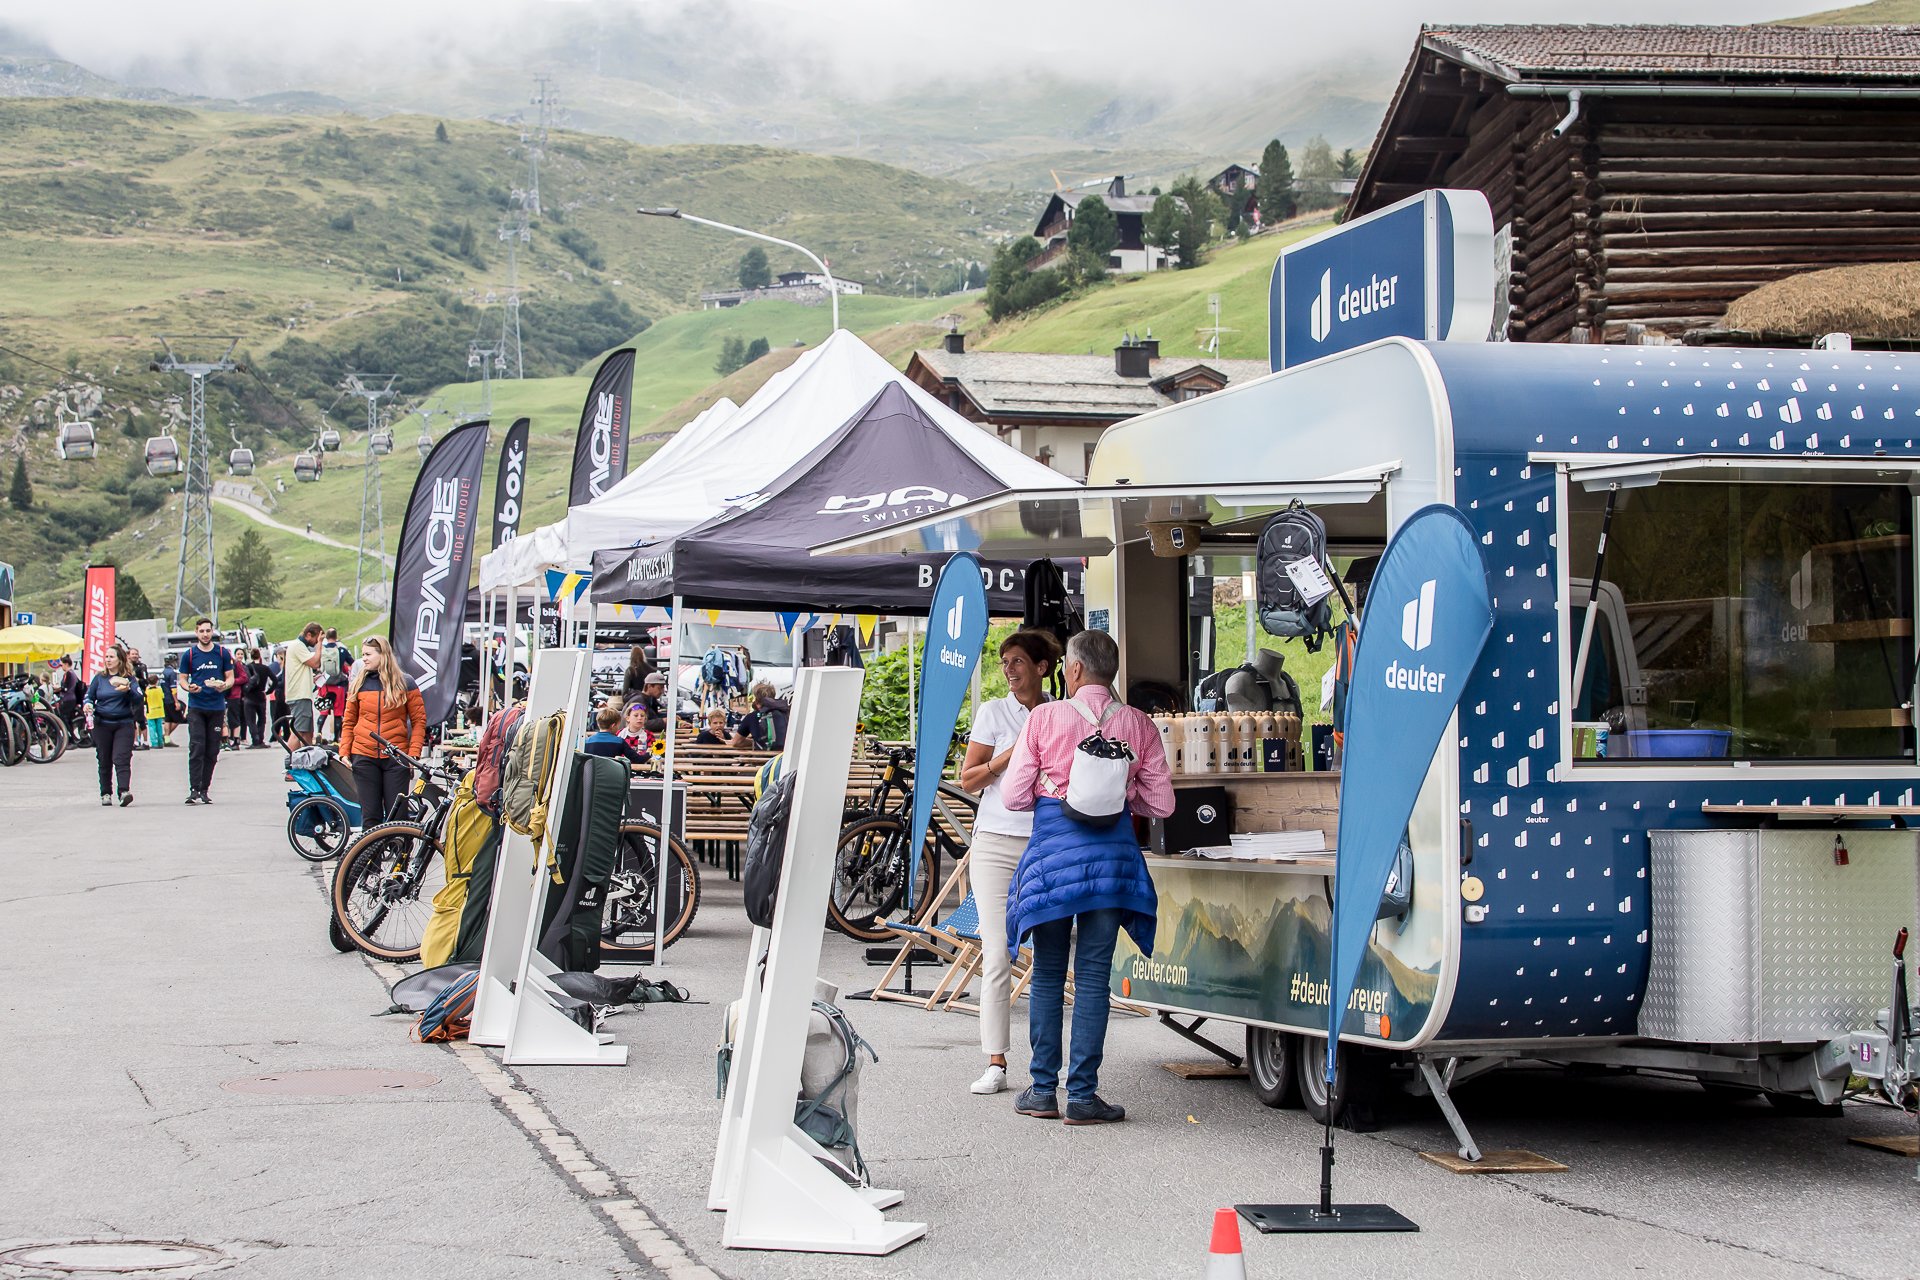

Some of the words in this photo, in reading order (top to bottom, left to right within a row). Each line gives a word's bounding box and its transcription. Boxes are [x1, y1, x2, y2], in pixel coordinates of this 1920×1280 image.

[1338, 273, 1398, 322] deuter
[613, 395, 622, 437] UNIQUE!
[612, 443, 620, 466] RIDE
[456, 477, 471, 528] UNIQUE!
[453, 533, 466, 562] RIDE
[412, 477, 459, 693] VPACE
[940, 645, 967, 669] deuter
[1385, 660, 1446, 693] deuter
[1525, 816, 1549, 824] deuter
[1132, 951, 1188, 986] deuter.com
